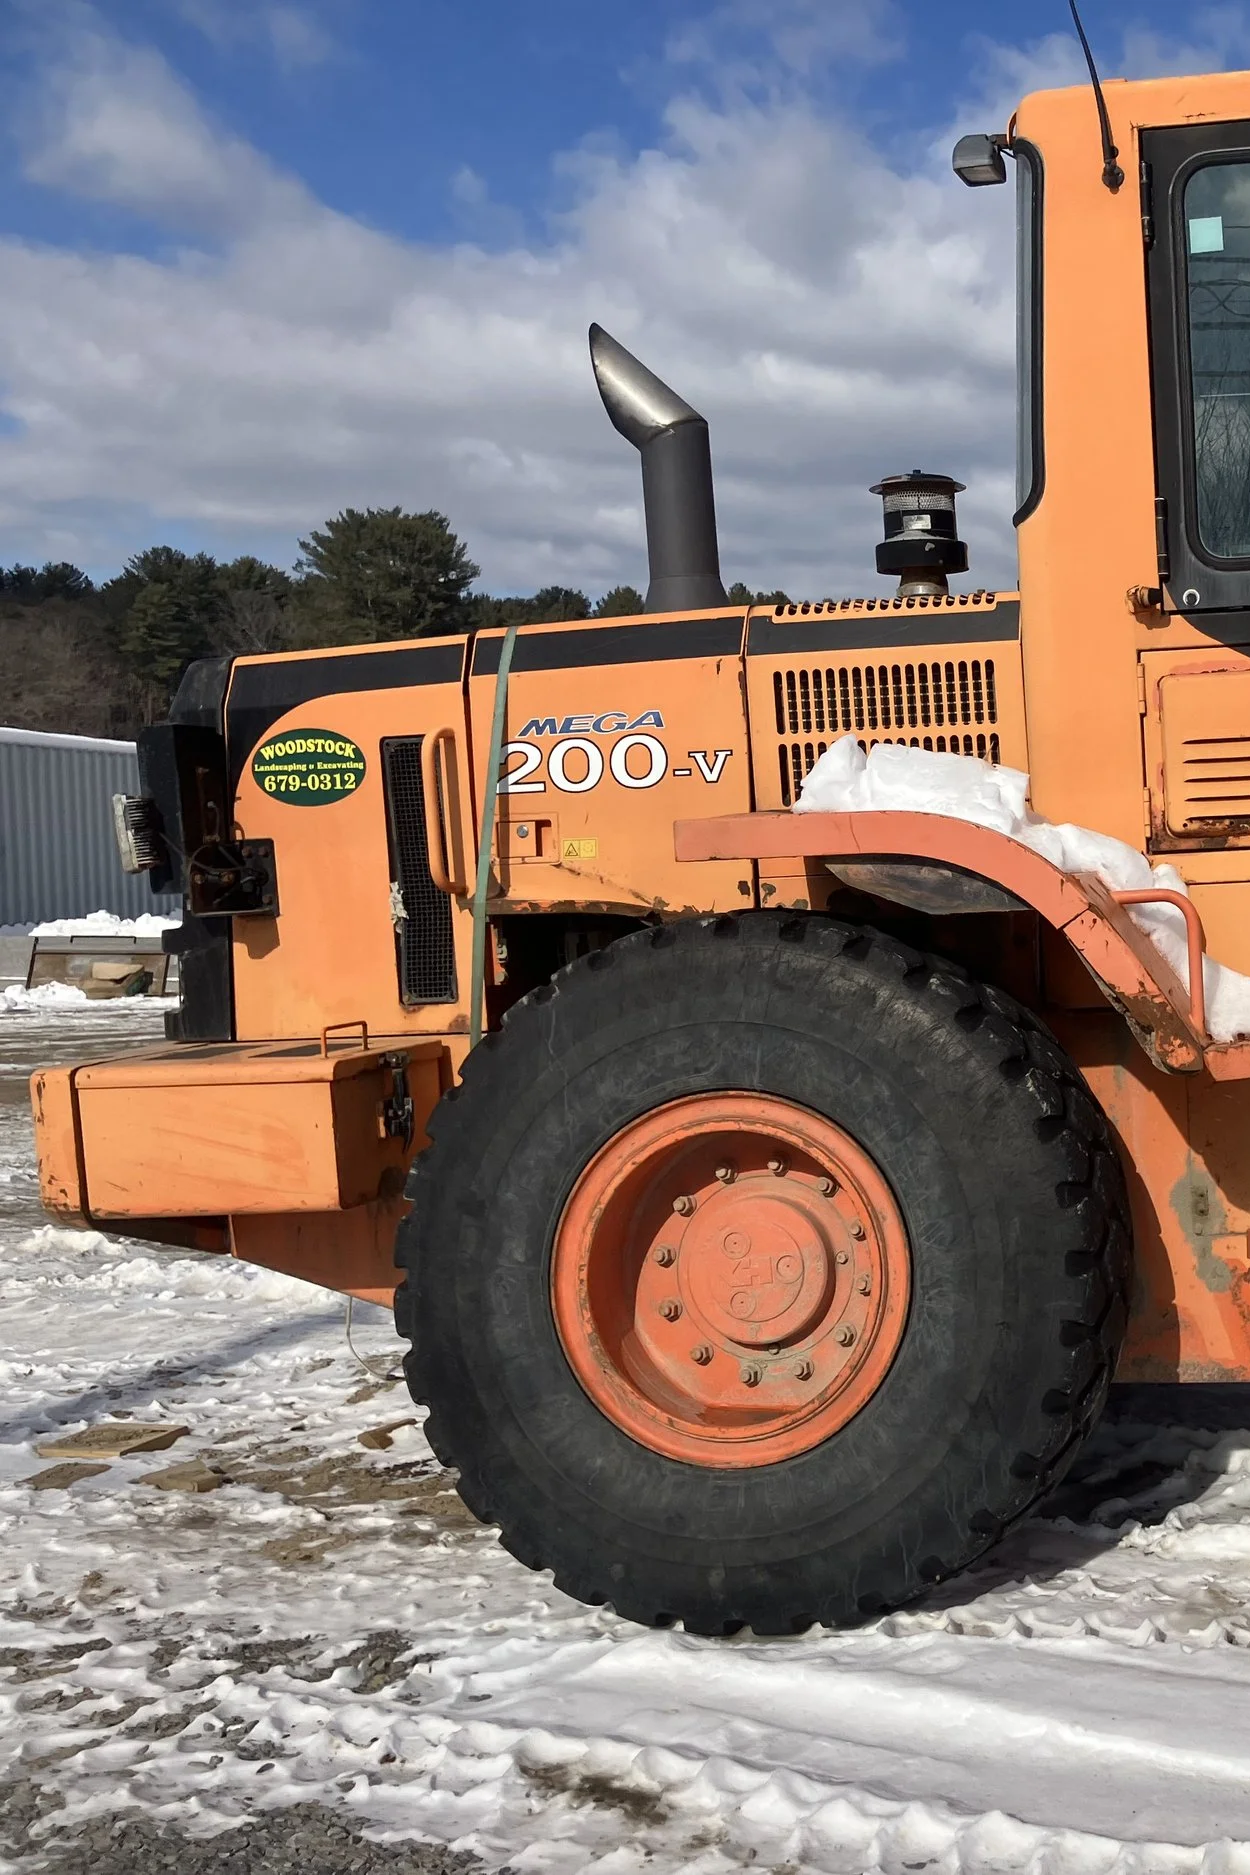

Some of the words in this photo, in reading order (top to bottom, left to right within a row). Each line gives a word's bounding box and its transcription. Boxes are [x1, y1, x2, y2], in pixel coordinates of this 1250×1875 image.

[516, 710, 666, 738] MEGA
[260, 738, 357, 761] WOODSTOCK
[254, 762, 307, 772] Landscaping
[316, 761, 364, 770] Excavating
[264, 773, 356, 792] 679-0312
